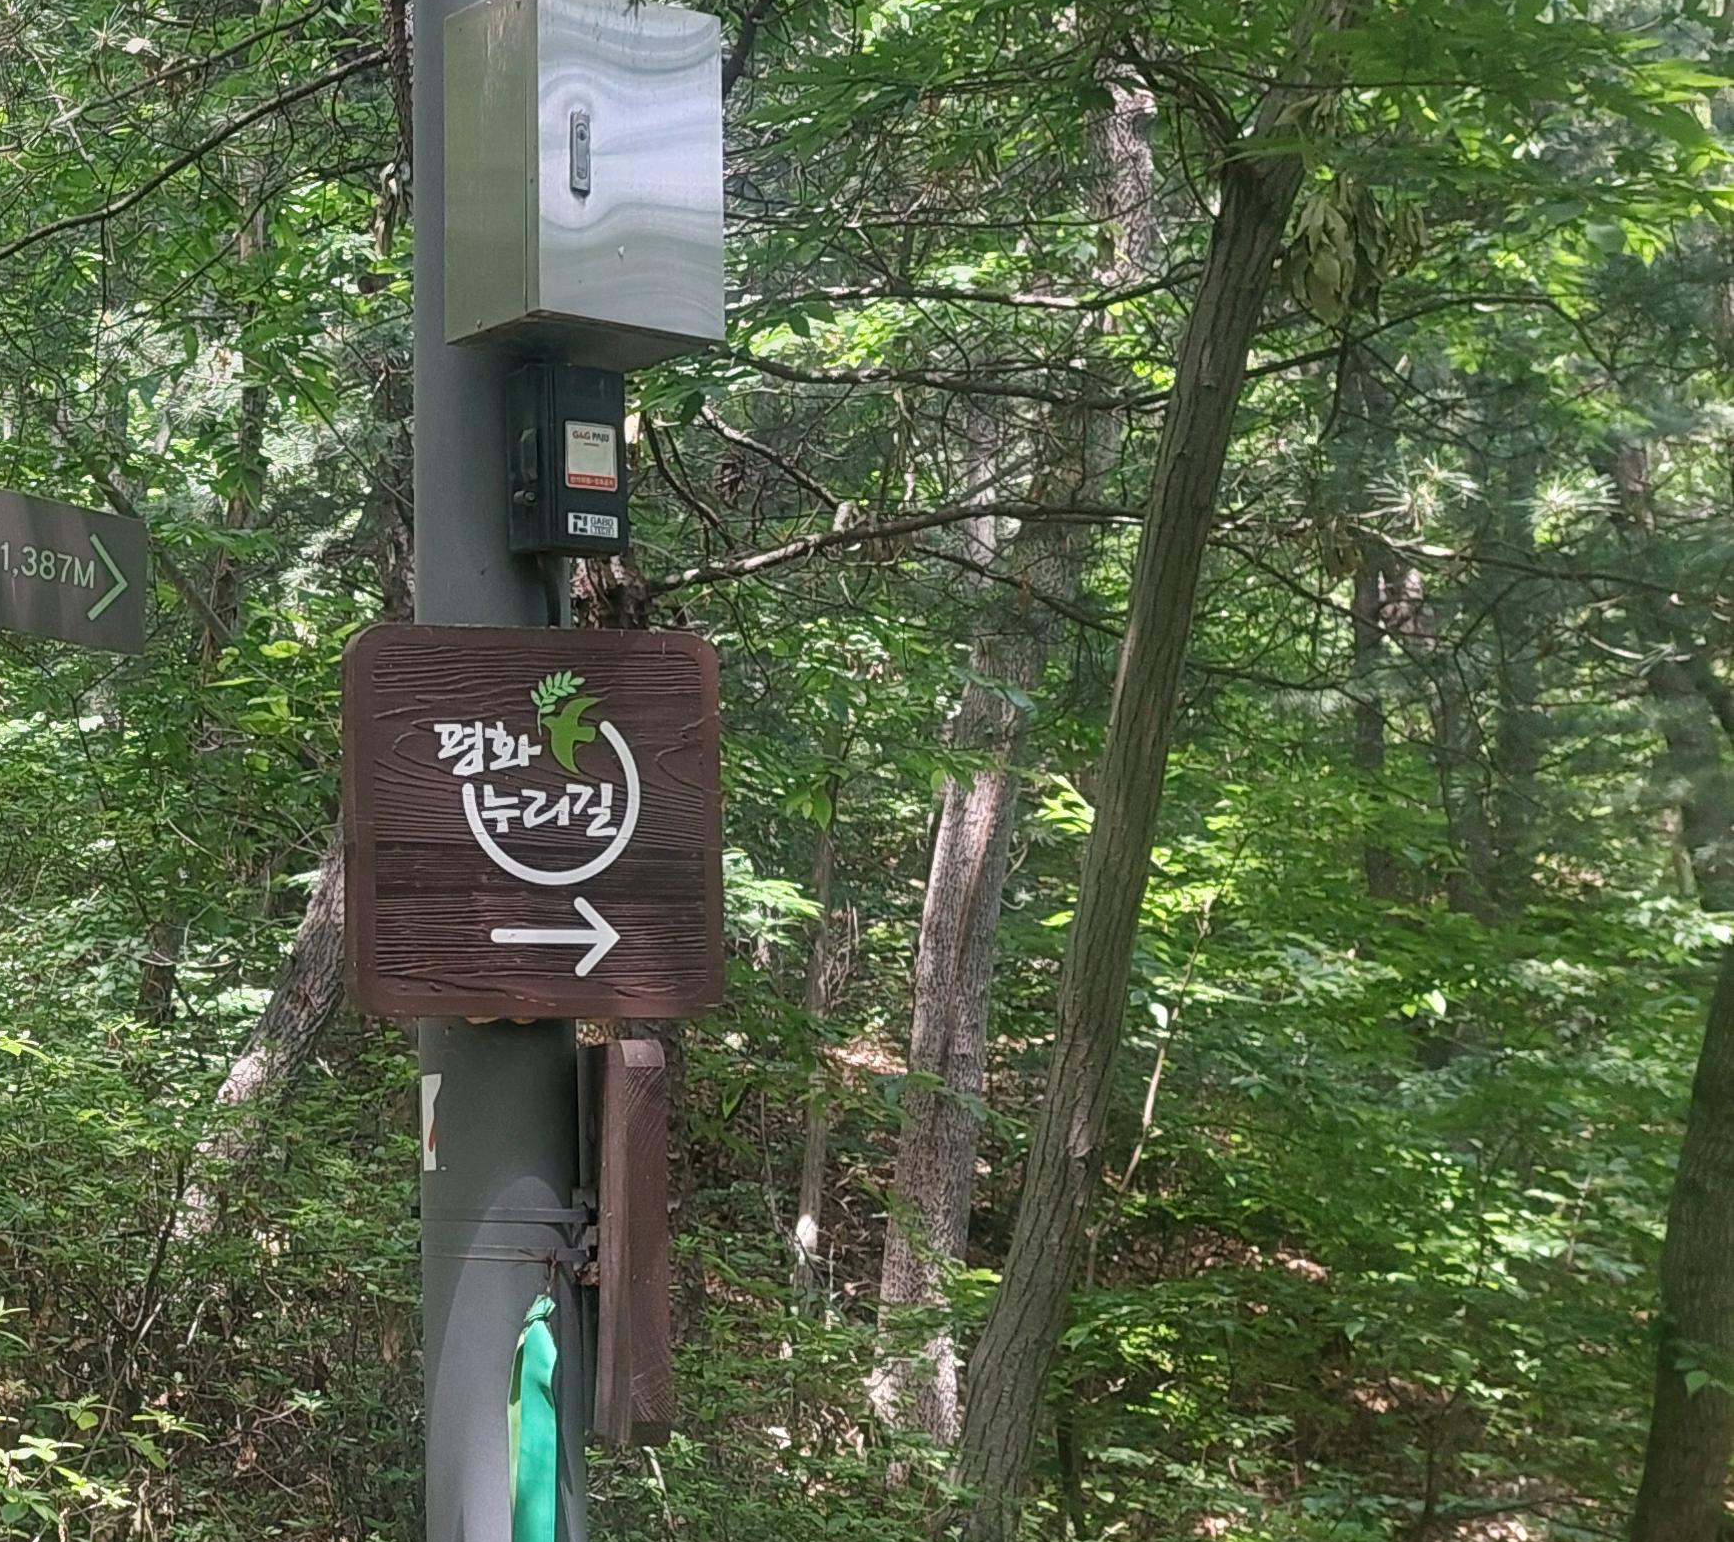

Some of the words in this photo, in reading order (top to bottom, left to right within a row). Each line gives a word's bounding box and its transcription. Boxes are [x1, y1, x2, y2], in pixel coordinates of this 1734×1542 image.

[0, 540, 96, 590] 1,387M
[433, 720, 543, 777] 평화
[480, 782, 618, 837] 누리길
